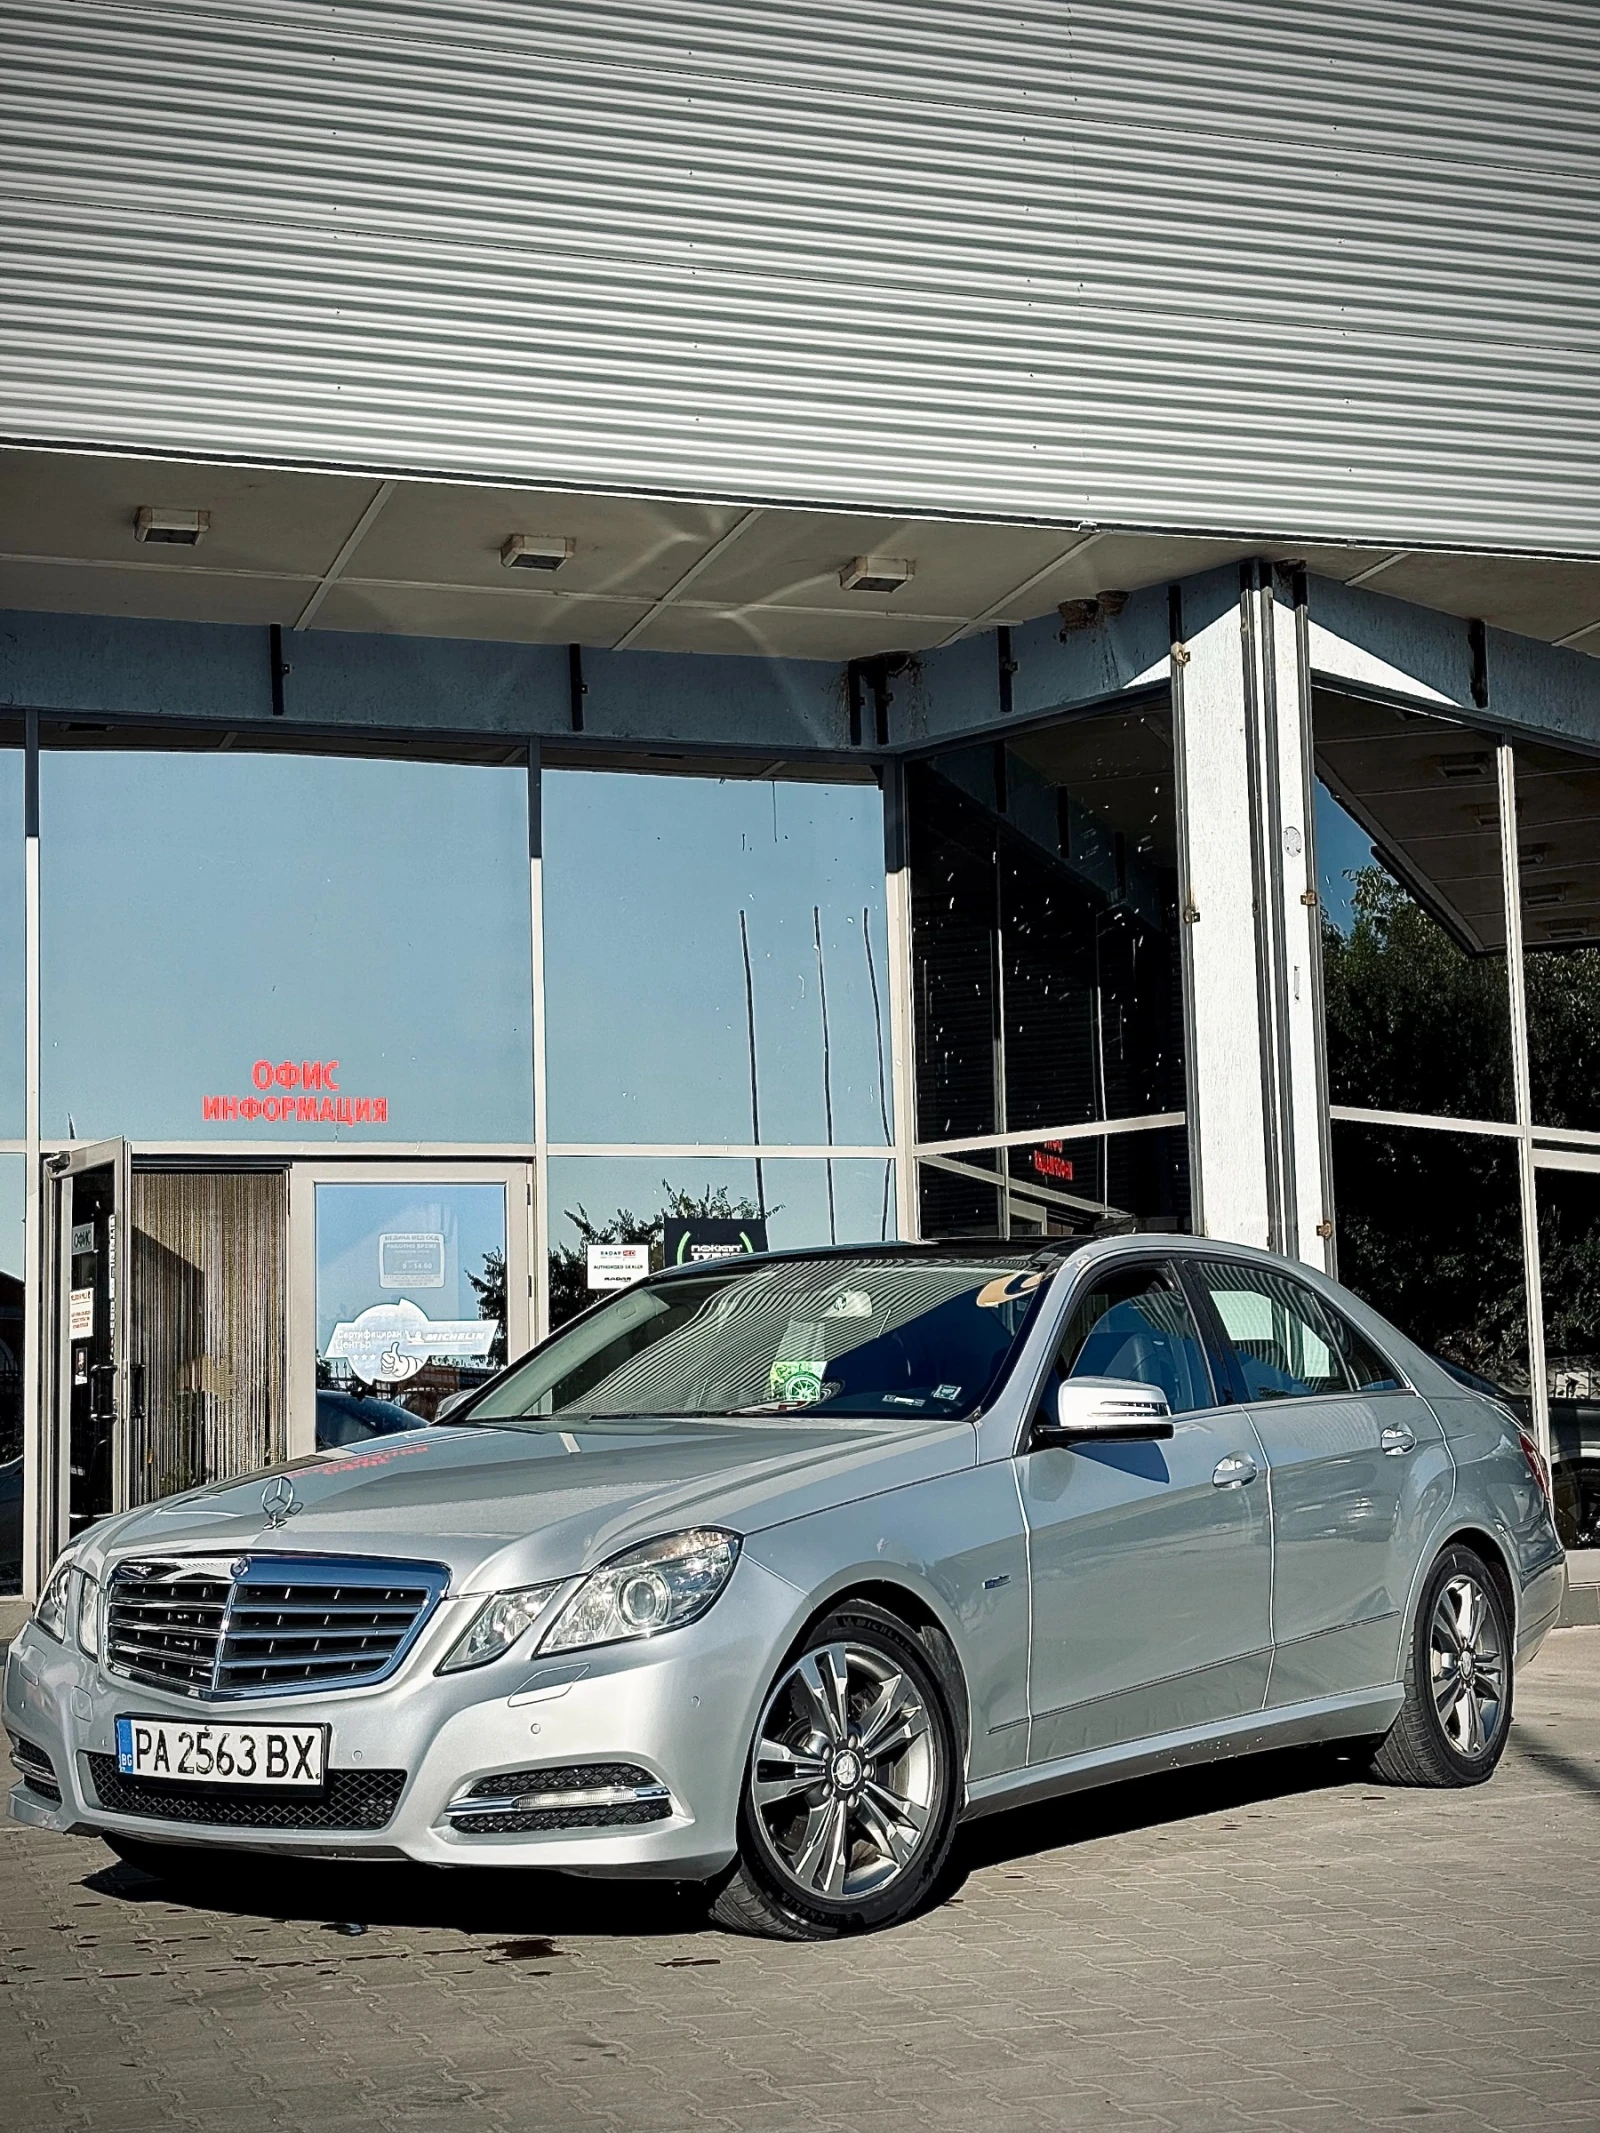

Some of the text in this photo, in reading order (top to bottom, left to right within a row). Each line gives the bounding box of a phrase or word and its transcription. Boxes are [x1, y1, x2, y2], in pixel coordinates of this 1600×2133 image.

[252, 1060, 340, 1091] ОФИС
[203, 1096, 388, 1127] ИНФОРМАЦИЯ
[74, 1229, 91, 1247] ОФИС
[691, 1244, 742, 1252] nokian
[336, 1330, 401, 1342] Сертифициран
[424, 1332, 486, 1341] MICHELIN
[335, 1339, 372, 1351] Център
[121, 1753, 133, 1767] BG
[135, 1727, 316, 1780] PA 2563 BX
